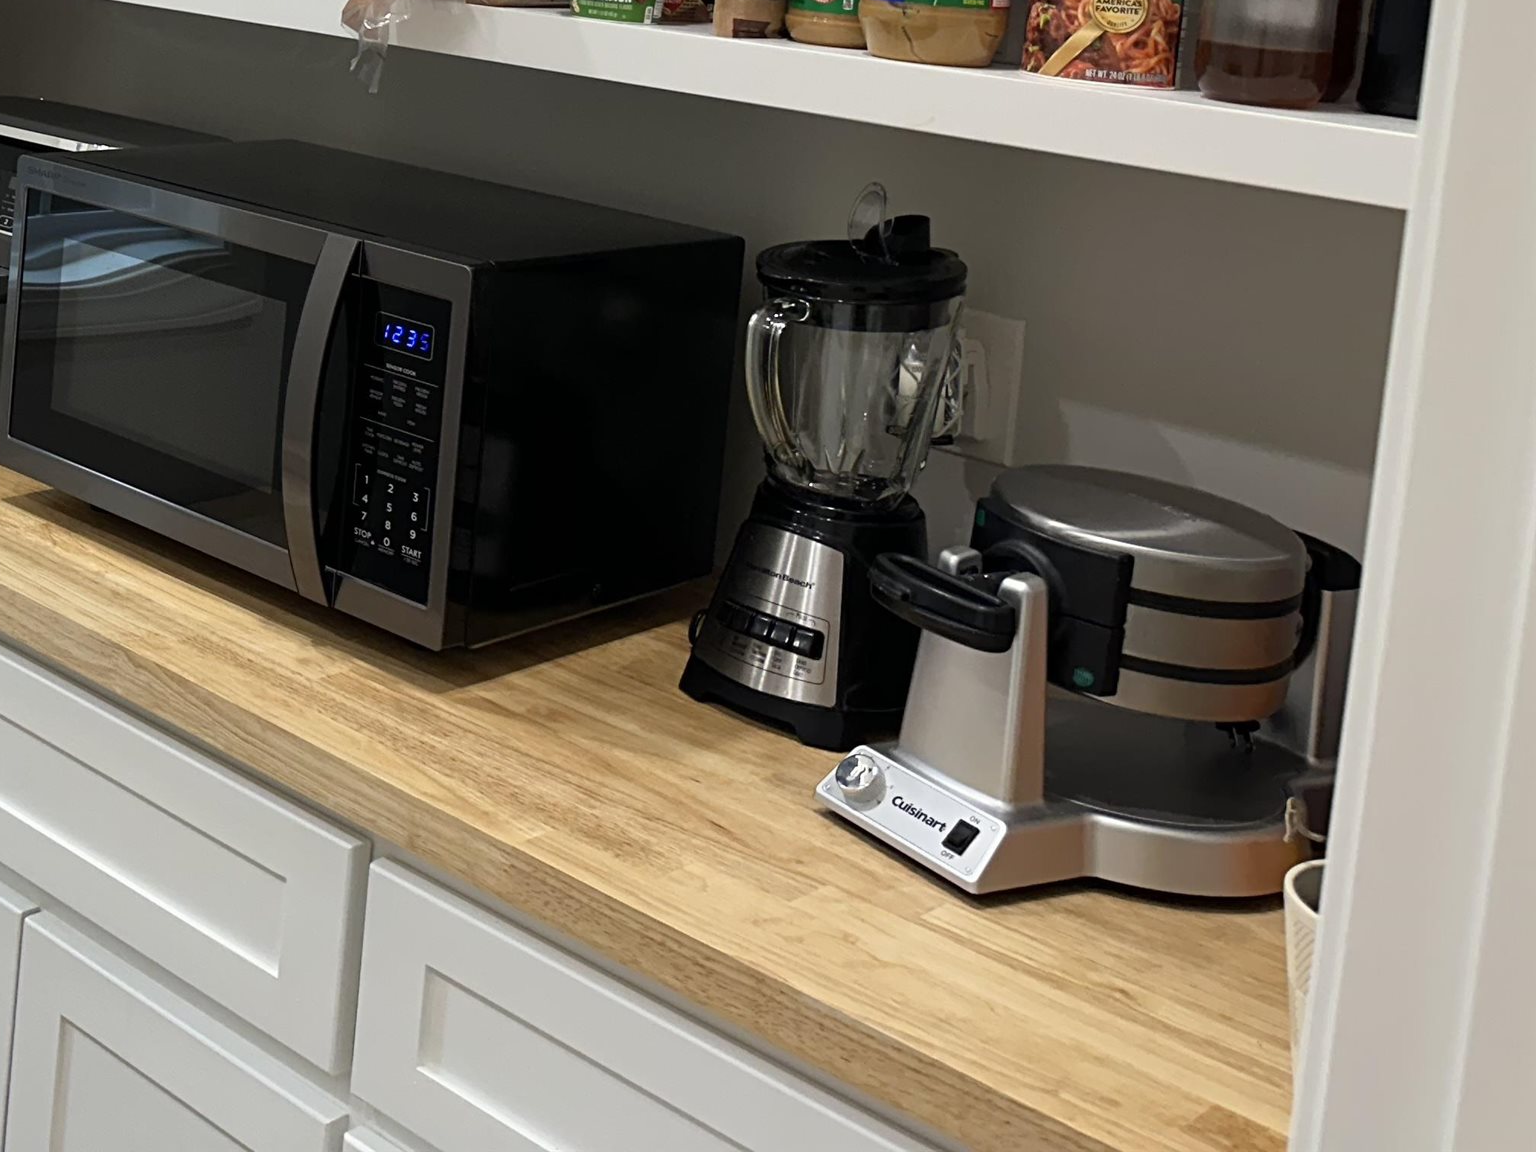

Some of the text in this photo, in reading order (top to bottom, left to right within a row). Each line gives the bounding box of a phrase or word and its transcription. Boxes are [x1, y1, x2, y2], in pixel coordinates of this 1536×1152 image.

[1095, 5, 1141, 15] FAVORITE
[1085, 68, 1096, 78] NET
[365, 475, 369, 485] 1
[387, 483, 394, 494] 2
[361, 494, 368, 503] 4
[412, 492, 419, 502] 3
[386, 502, 393, 512] 5
[361, 511, 367, 520] 7
[410, 512, 418, 522] 6
[384, 520, 391, 530] 8
[354, 527, 372, 539] STOP
[409, 529, 416, 539] 9
[383, 537, 390, 547] 0
[401, 545, 422, 559] START
[892, 795, 947, 833] Cuisinart
[969, 815, 981, 825] ON
[940, 850, 955, 860] OFF
